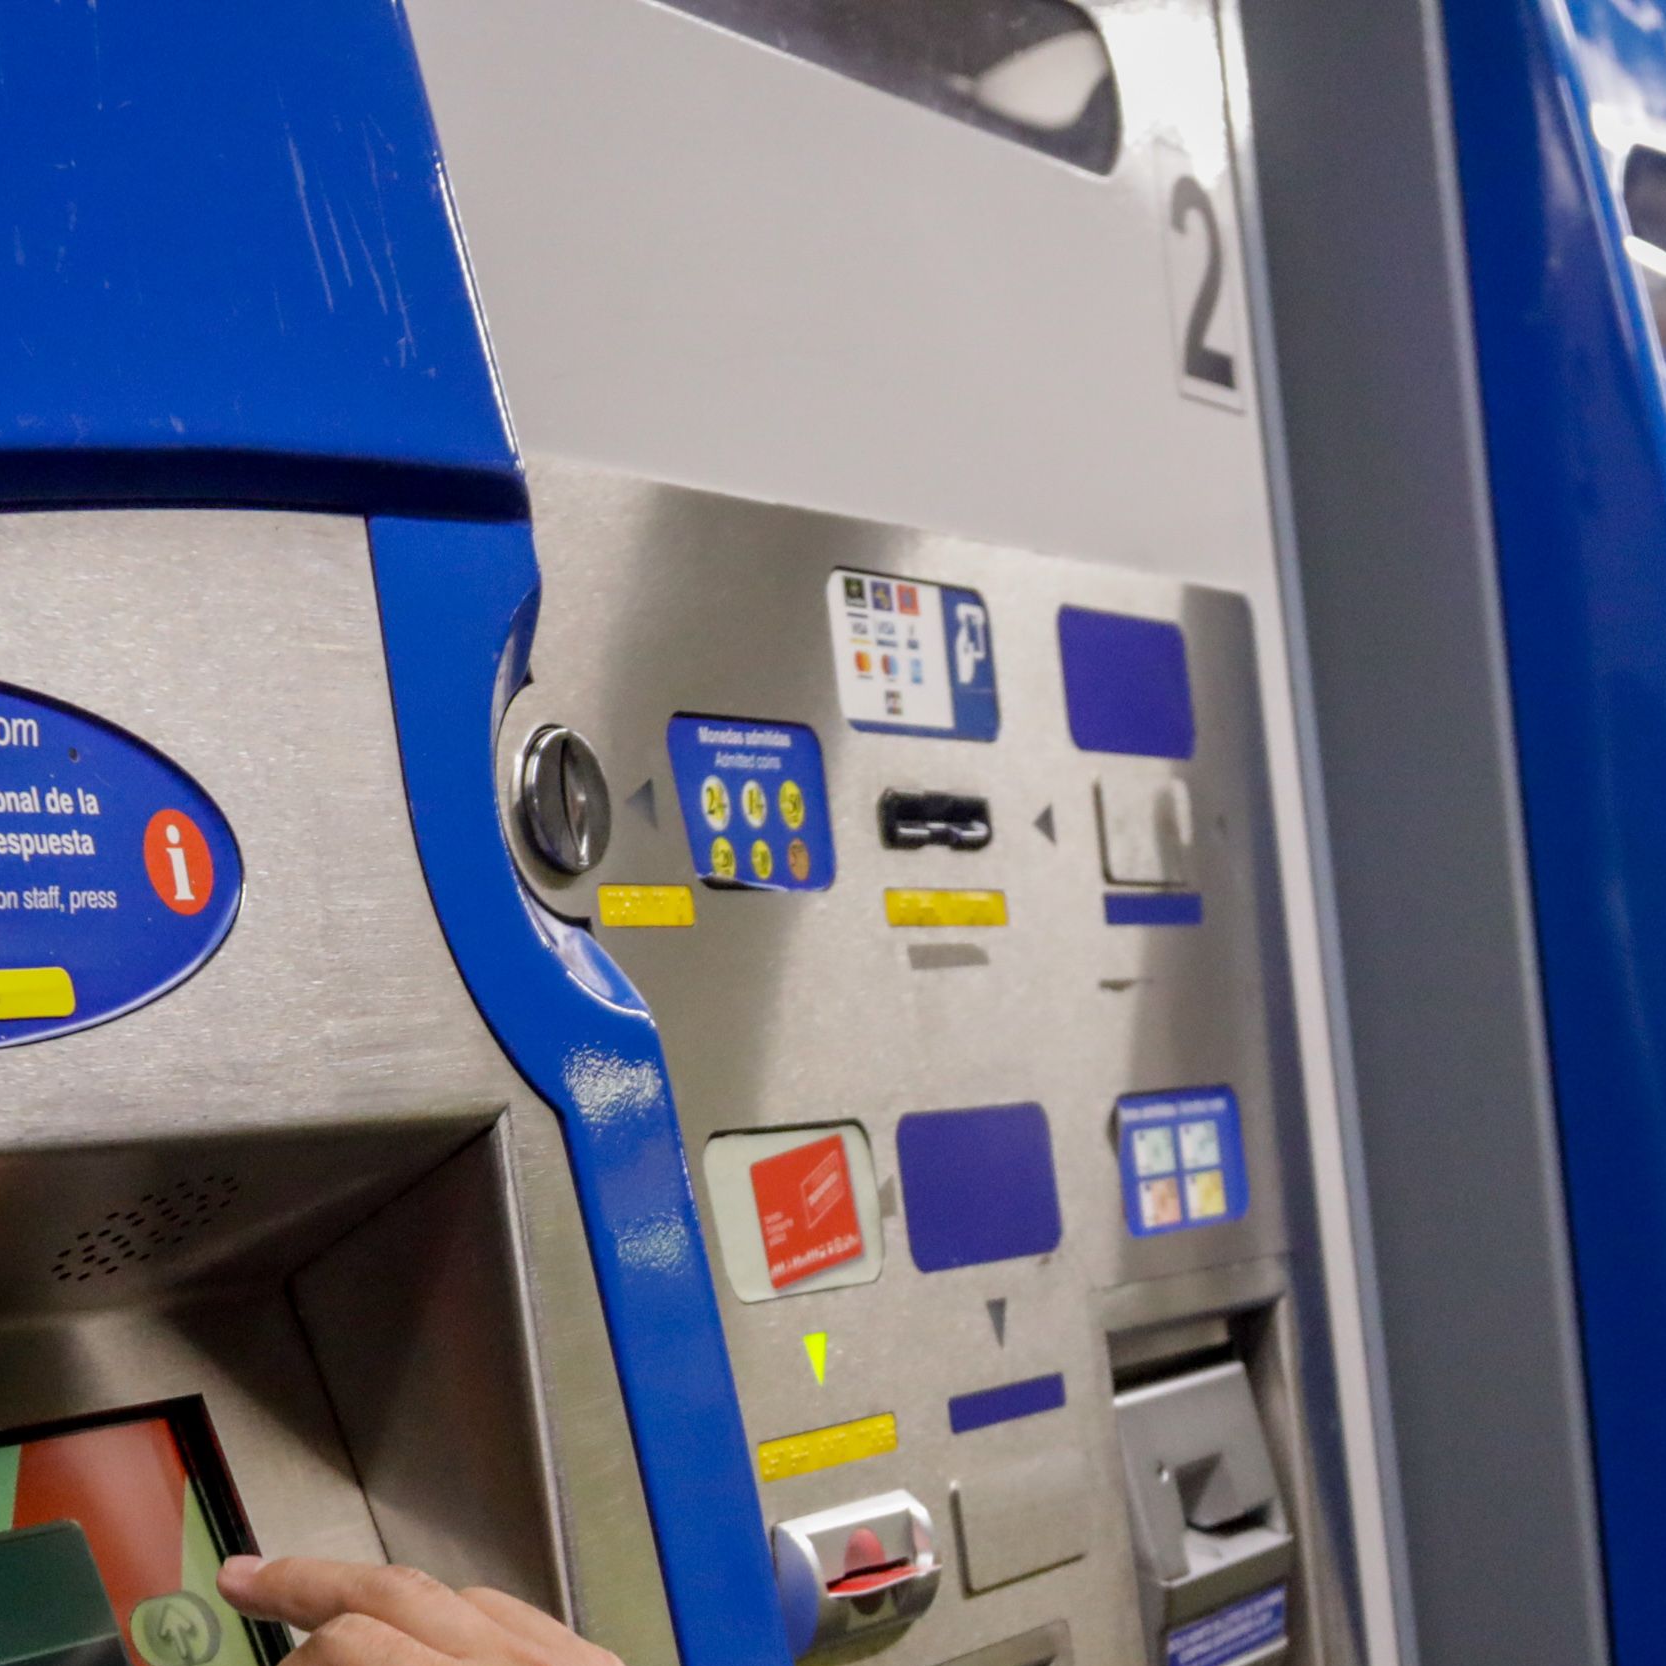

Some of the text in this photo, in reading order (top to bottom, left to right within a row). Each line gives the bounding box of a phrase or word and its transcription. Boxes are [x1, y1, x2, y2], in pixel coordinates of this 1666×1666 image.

[1171, 174, 1237, 390] 2
[45, 786, 74, 815] de
[77, 788, 100, 815] la
[23, 885, 65, 912] staff,
[69, 889, 117, 914] press
